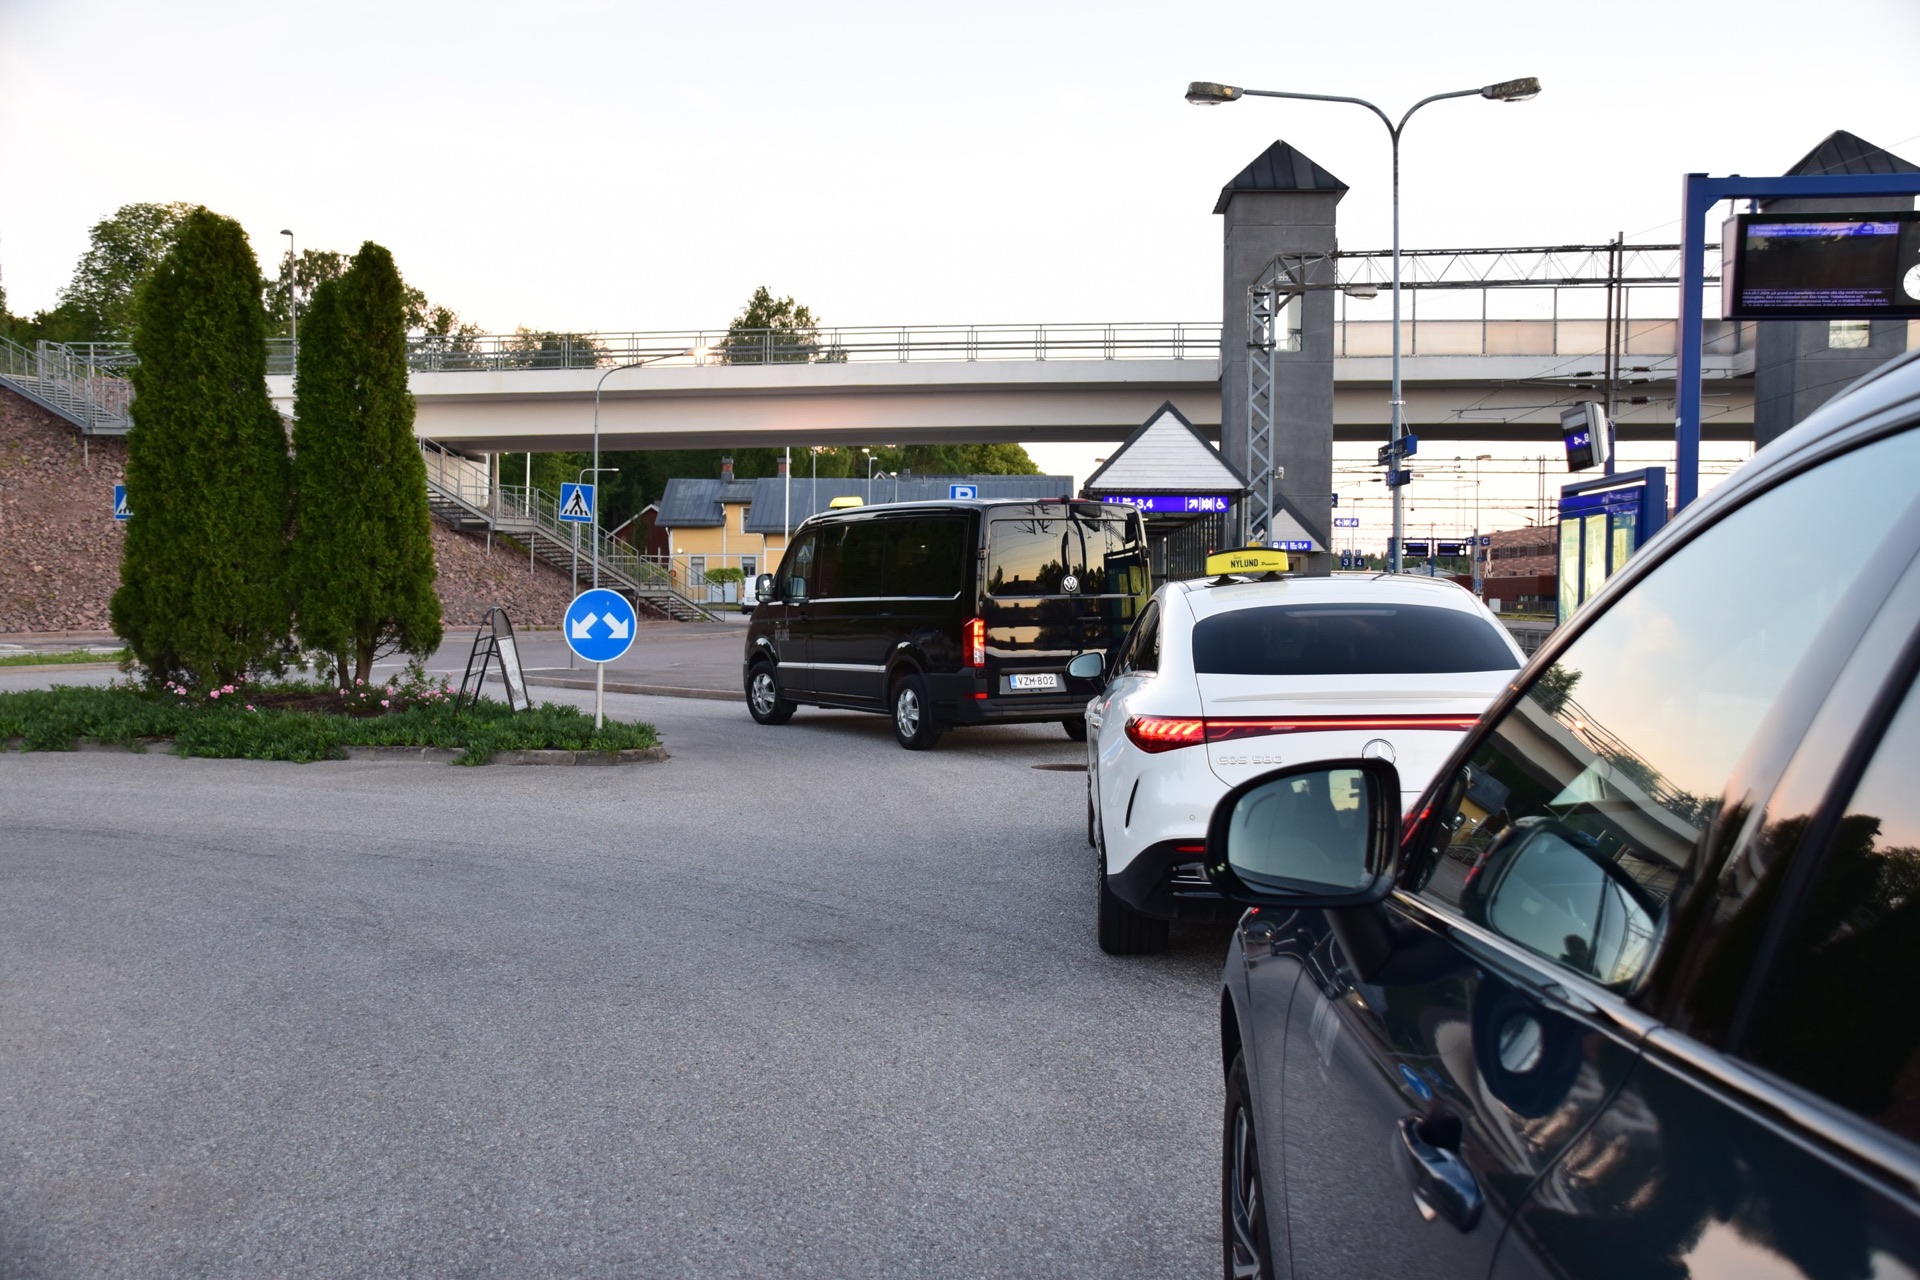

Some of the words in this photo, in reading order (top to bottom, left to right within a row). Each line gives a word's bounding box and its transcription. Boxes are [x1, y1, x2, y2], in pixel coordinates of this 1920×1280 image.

[1136, 498, 1154, 511] 3,4
[1482, 537, 1489, 545] C
[1298, 542, 1308, 550] 3,4
[1230, 558, 1259, 568] NYLUND
[1343, 558, 1349, 566] 3
[1356, 558, 1362, 566] 4
[1017, 675, 1055, 686] VZM-802
[1252, 754, 1284, 765] 580
